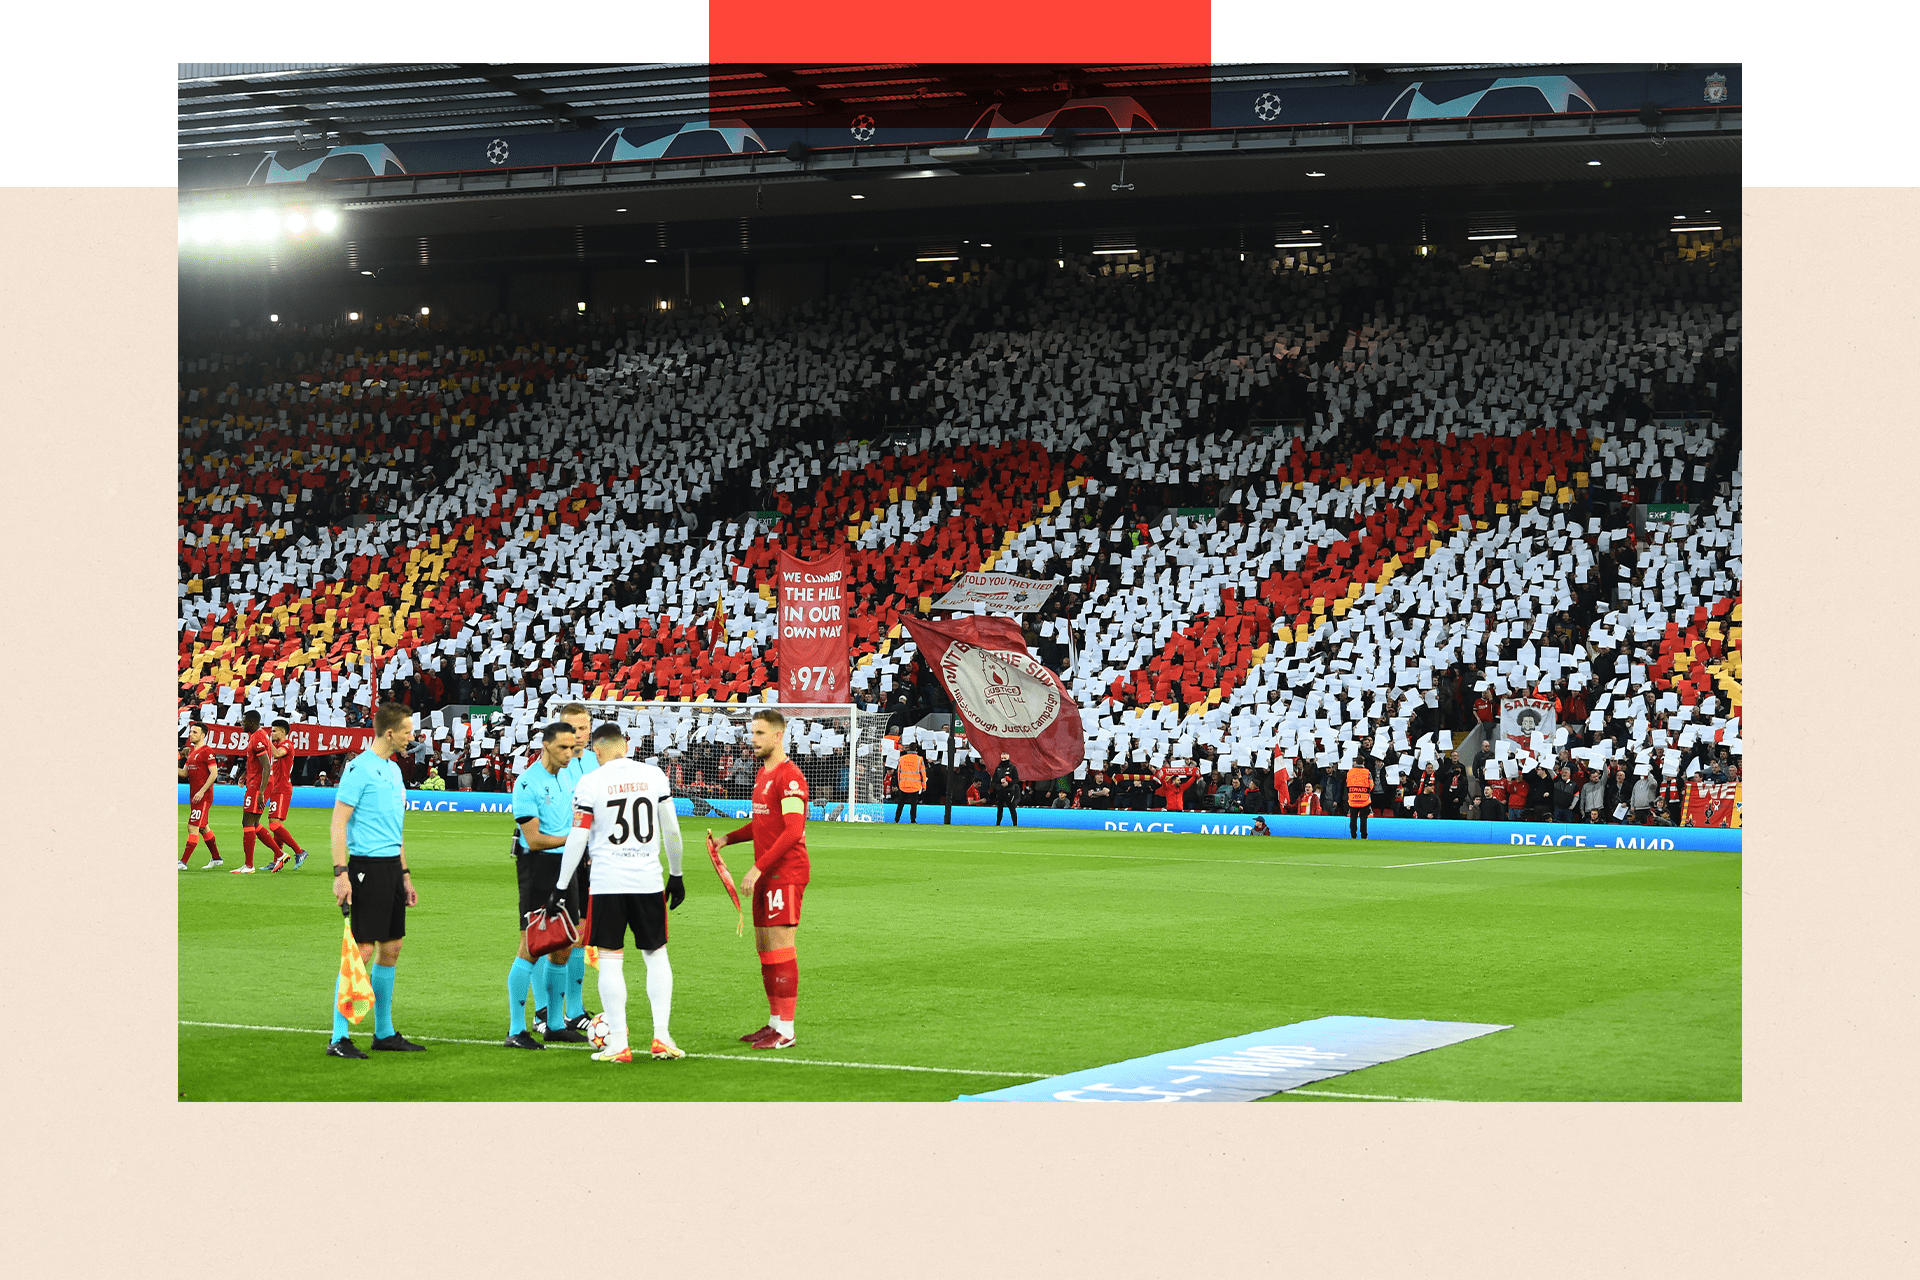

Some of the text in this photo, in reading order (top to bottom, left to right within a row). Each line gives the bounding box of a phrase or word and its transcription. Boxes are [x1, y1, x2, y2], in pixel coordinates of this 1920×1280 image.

[783, 571, 801, 583] WE
[964, 574, 987, 586] TOLD
[989, 576, 1007, 586] YOU
[1008, 578, 1032, 590] THEY
[1032, 583, 1053, 591] LIED
[784, 586, 842, 602] THE HILL
[784, 604, 841, 623] IN OUR
[783, 624, 843, 639] OWN WAY
[797, 666, 828, 691] 97
[987, 687, 1017, 695] JUSTICE
[953, 687, 998, 732] Hillsborough
[1030, 693, 1059, 731] Campaign
[1504, 699, 1552, 712] SALAH
[317, 732, 351, 751] LAW
[608, 782, 649, 795] OTAMENDI
[191, 809, 202, 820] 20
[606, 796, 653, 845] 30
[766, 888, 785, 911] 14
